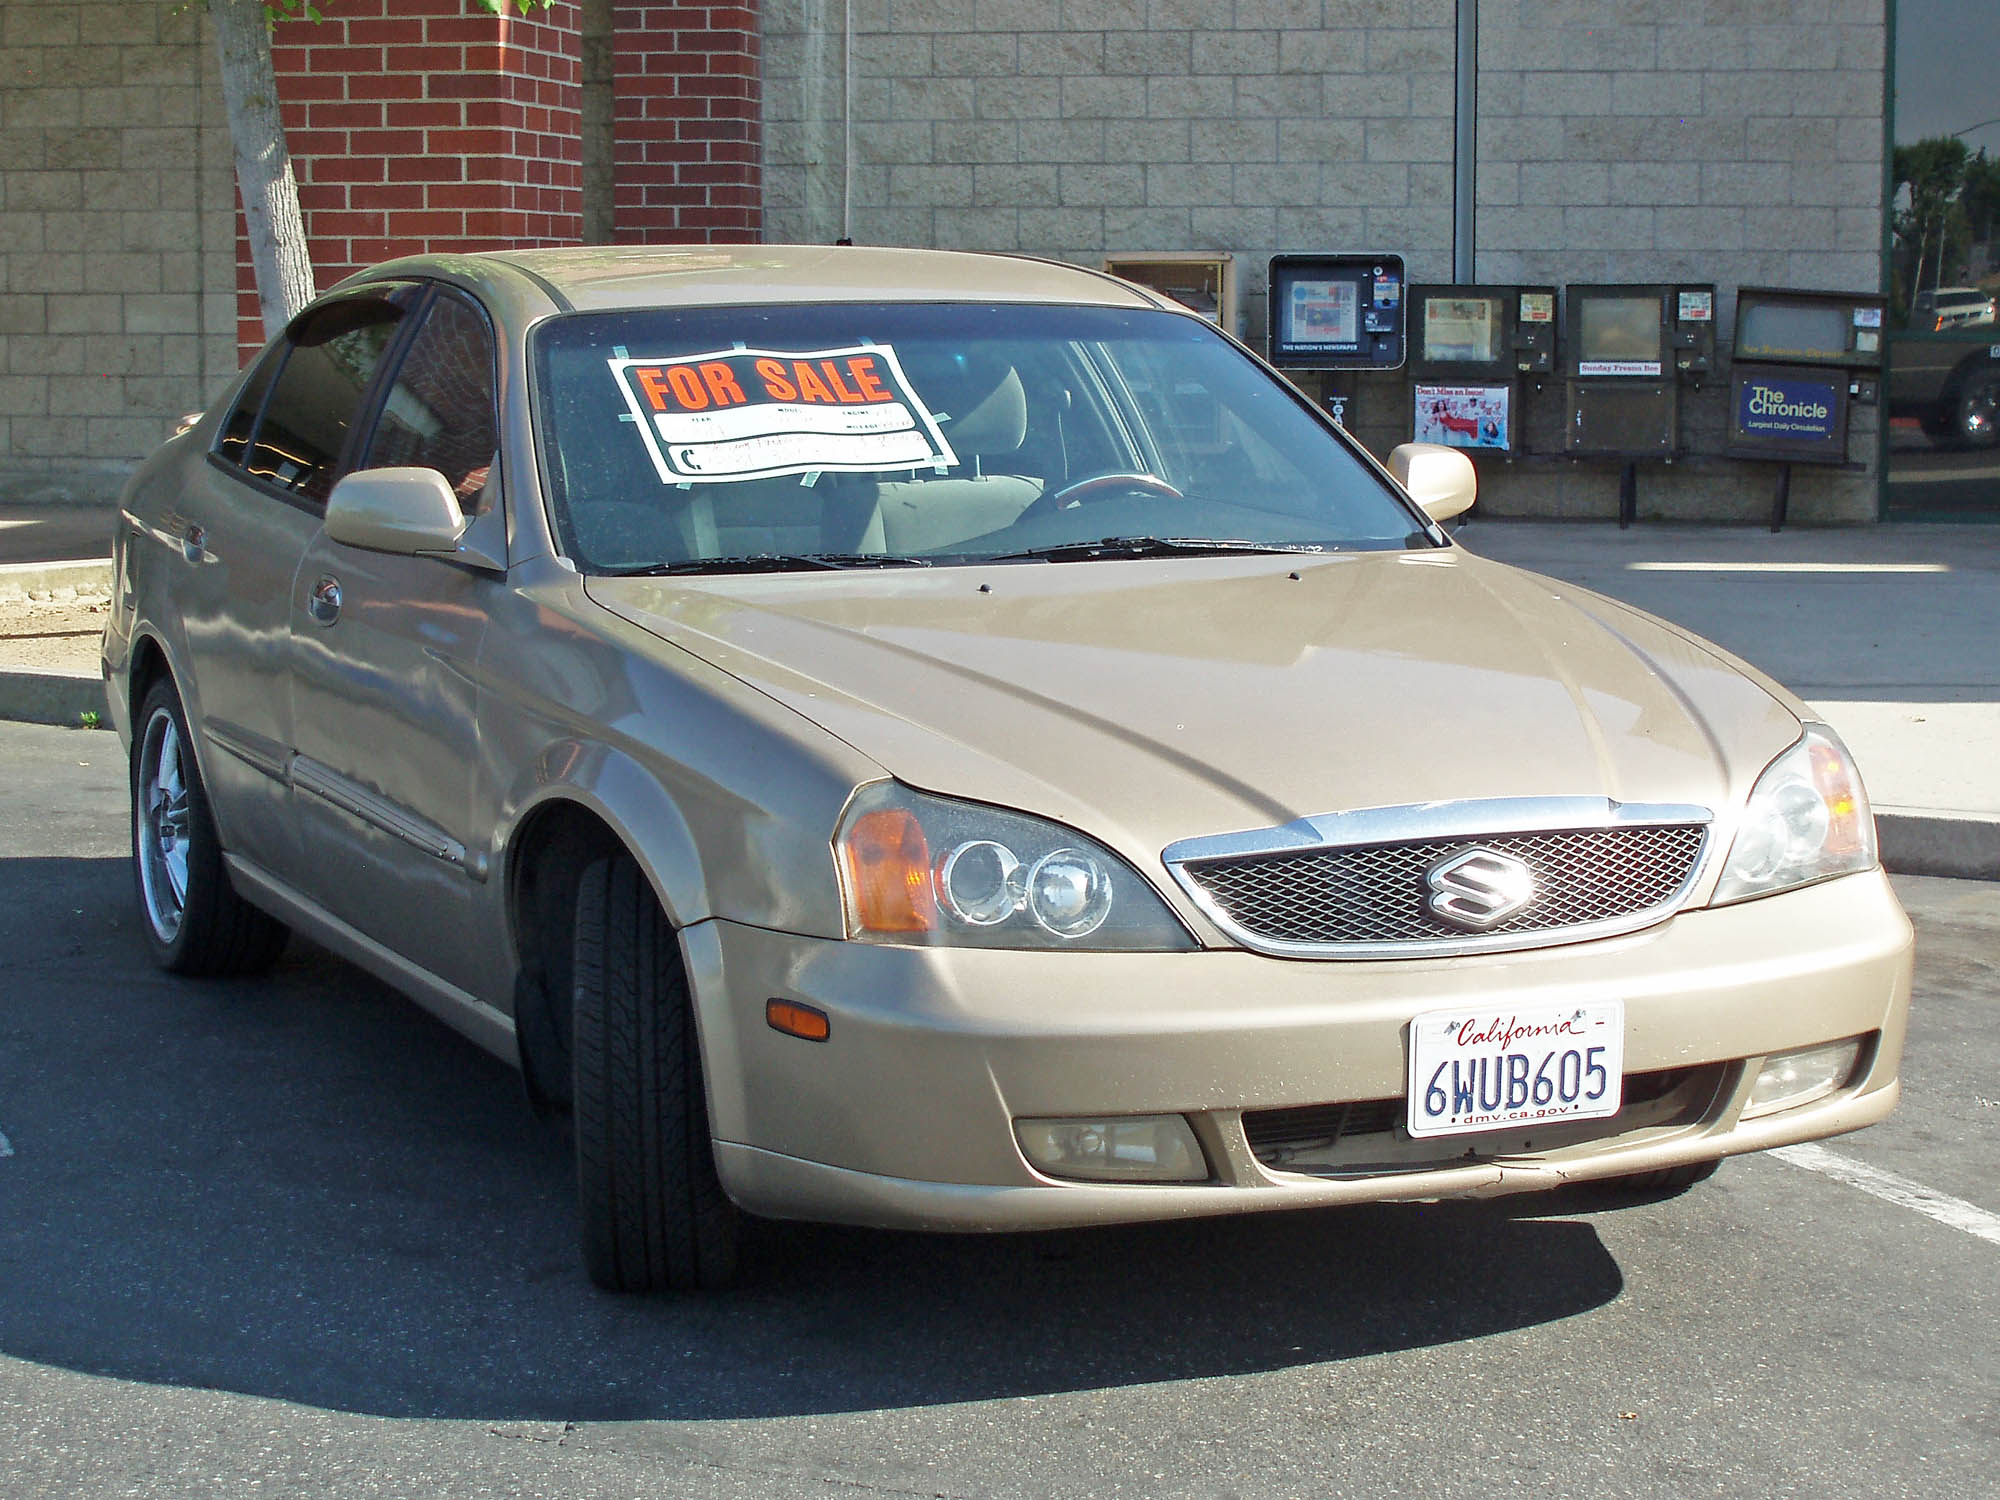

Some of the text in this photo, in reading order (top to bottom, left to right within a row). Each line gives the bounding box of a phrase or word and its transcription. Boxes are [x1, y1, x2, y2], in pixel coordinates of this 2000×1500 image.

[636, 357, 894, 411] FOR SALE
[1417, 387, 1435, 396] Don't
[1436, 387, 1454, 396] Miss
[1752, 386, 1785, 404] The
[1748, 398, 1828, 419] Chronicle
[1748, 420, 1773, 430] Largest
[1773, 422, 1790, 431] Daily
[1457, 1016, 1585, 1051] California
[1425, 1046, 1607, 1117] 6WUB605
[1463, 1105, 1569, 1124] dmv.ca.gov
